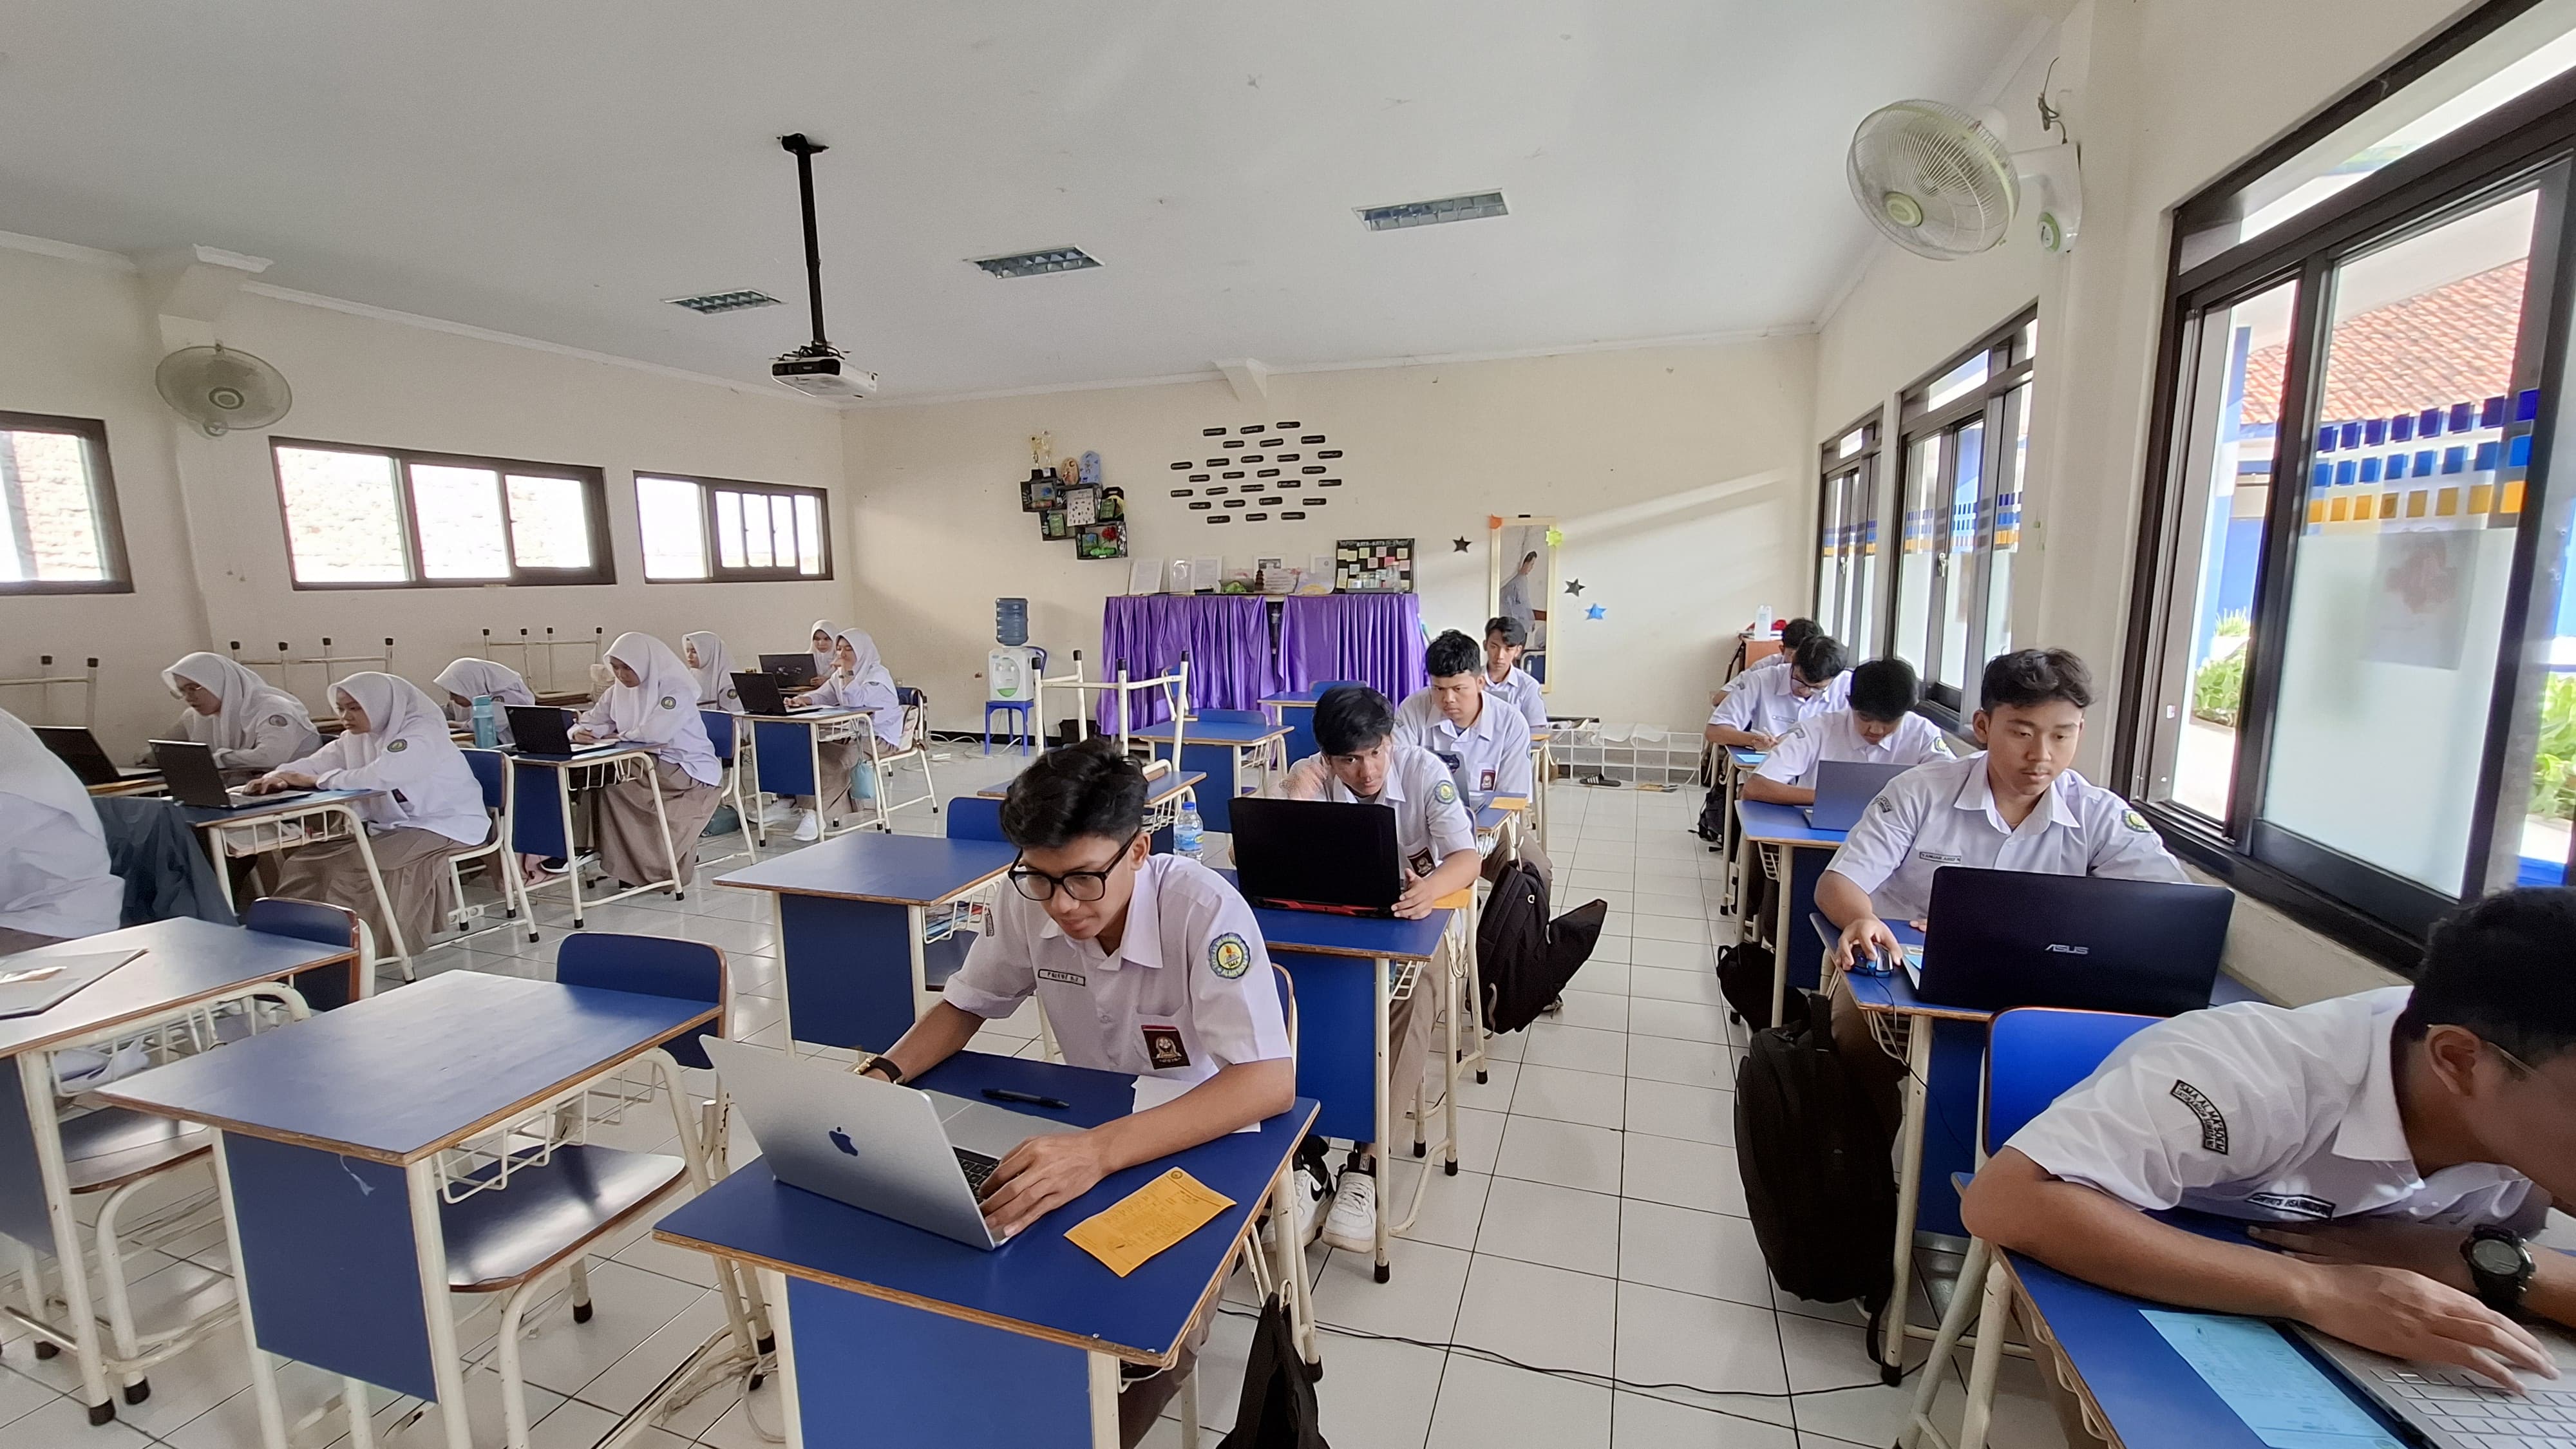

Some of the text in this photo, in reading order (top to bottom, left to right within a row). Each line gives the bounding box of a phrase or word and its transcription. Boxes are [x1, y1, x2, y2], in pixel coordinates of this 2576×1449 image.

[2044, 943, 2089, 954] ASUS
[2179, 1083, 2199, 1100] SMA
[2196, 1100, 2211, 1111] AL
